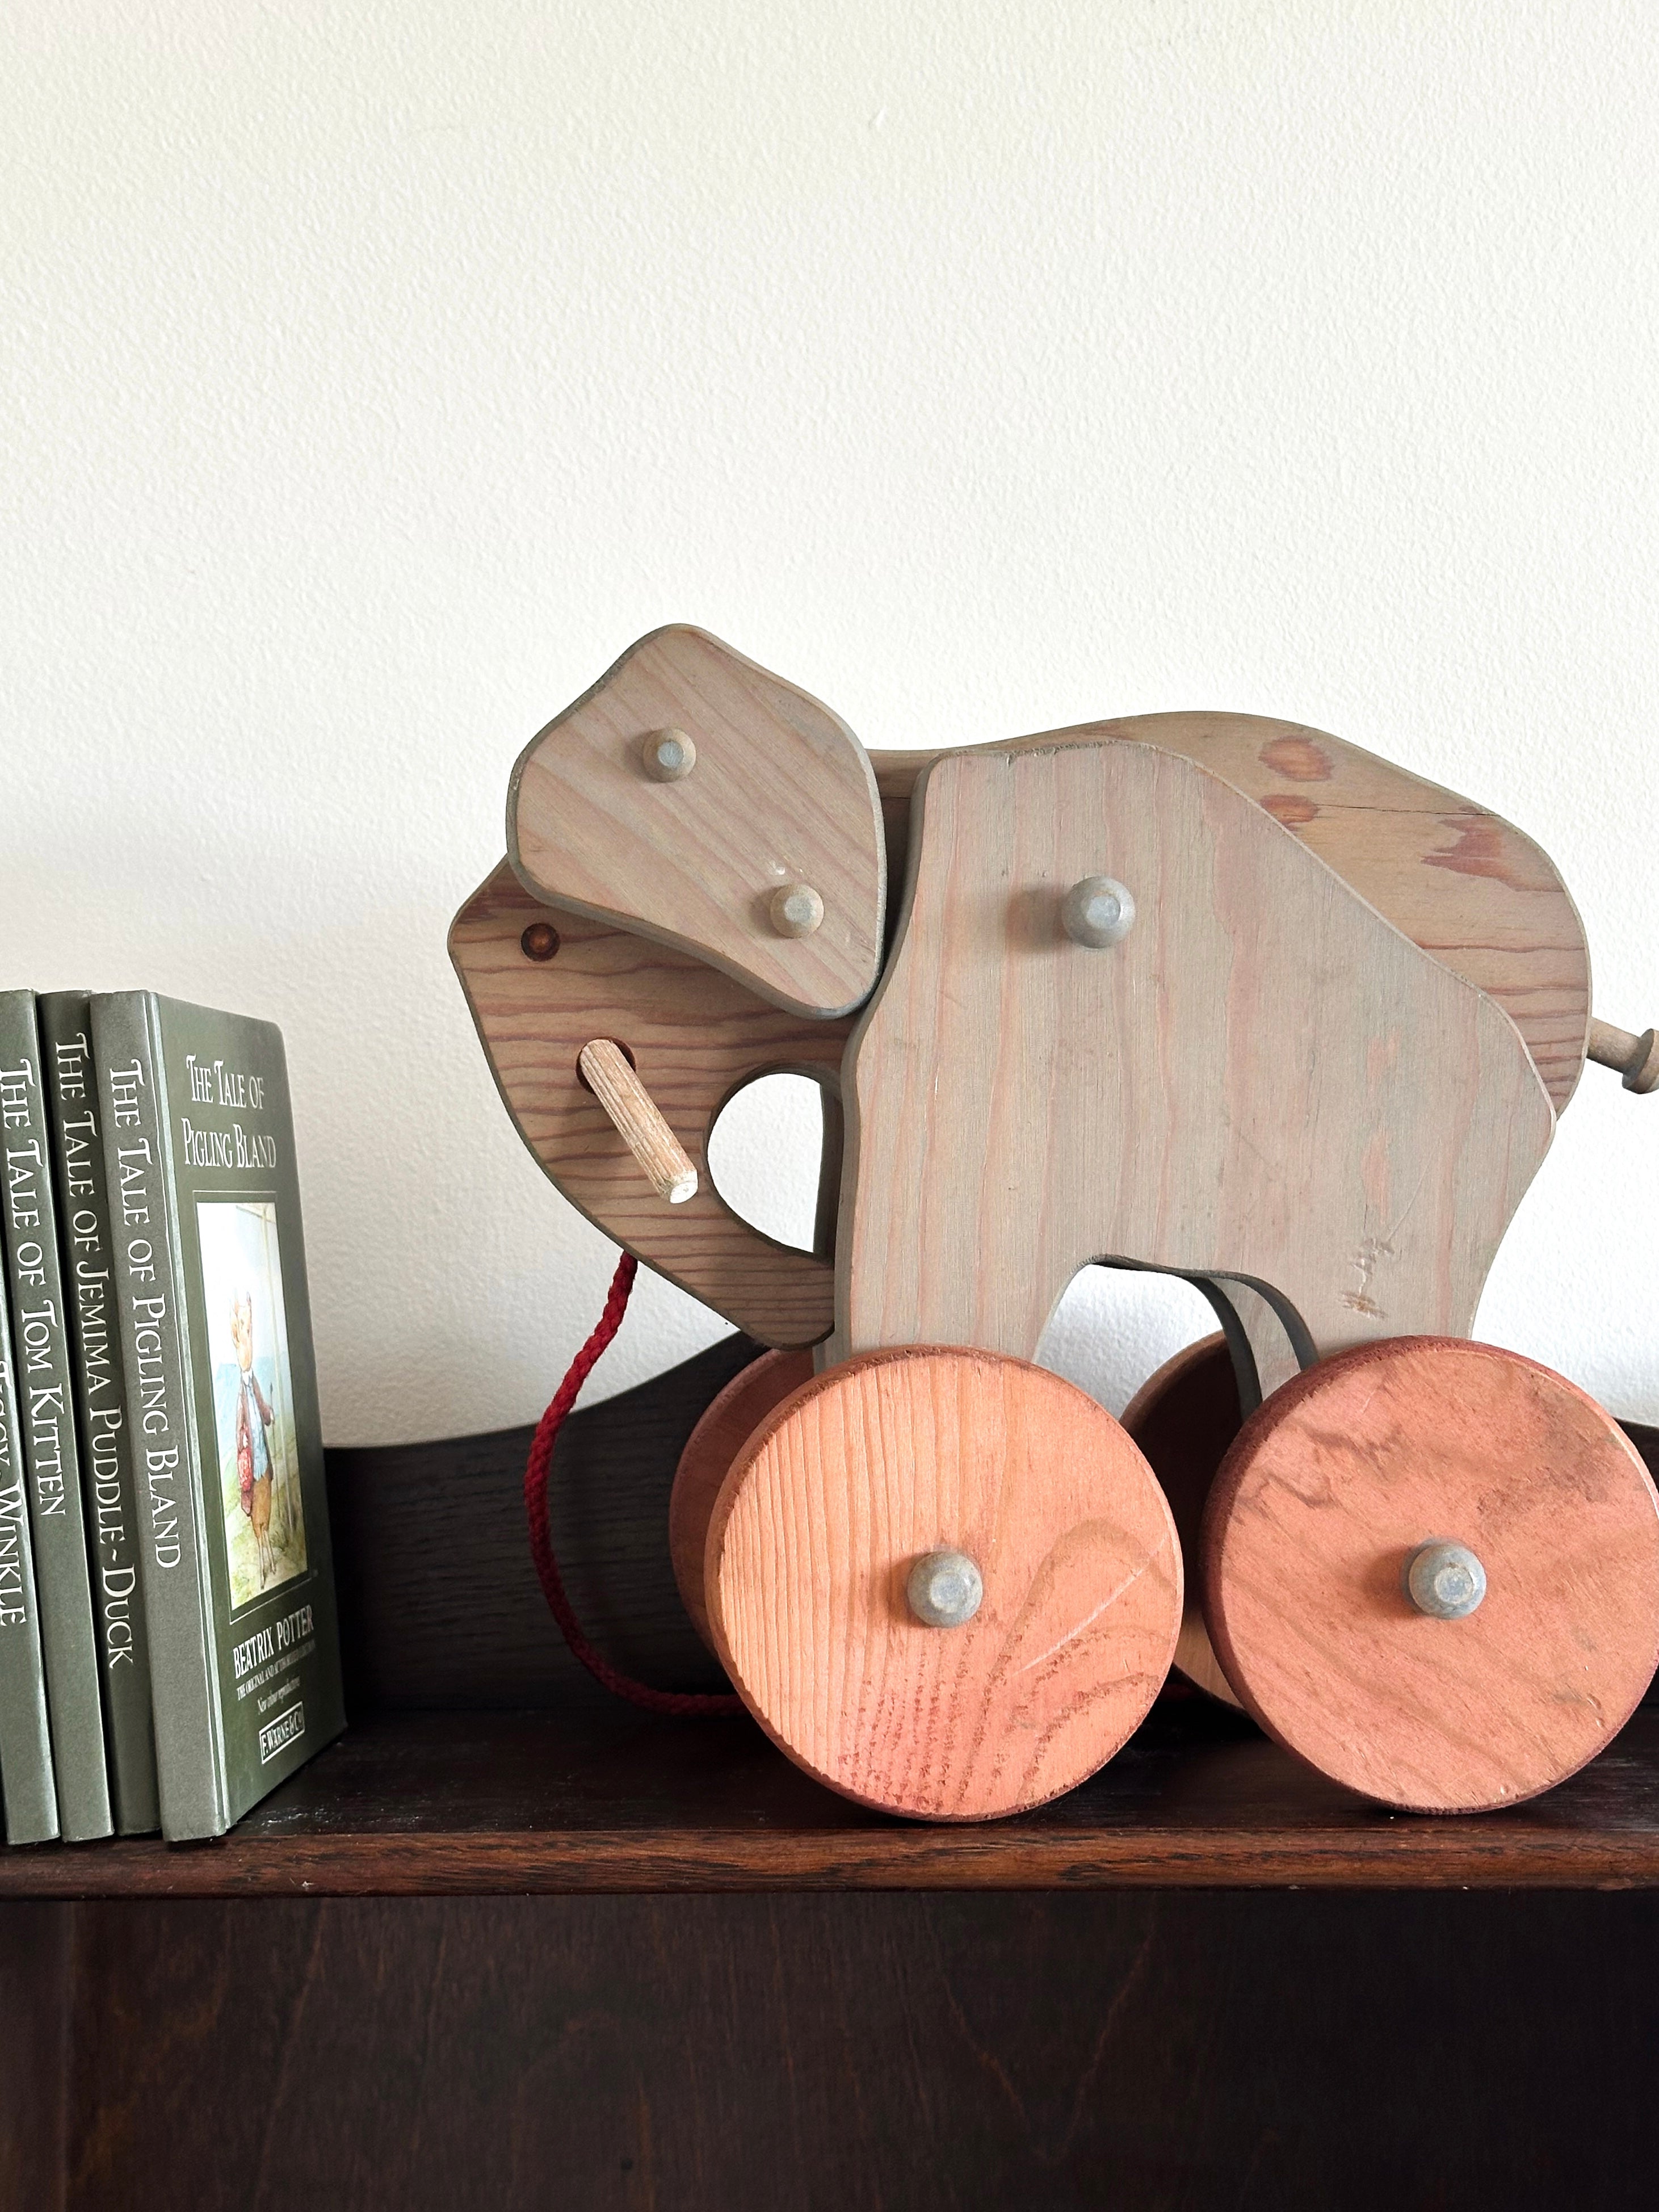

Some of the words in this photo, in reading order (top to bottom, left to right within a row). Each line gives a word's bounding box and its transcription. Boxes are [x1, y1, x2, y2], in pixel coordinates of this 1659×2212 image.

[0, 1058, 36, 1129] THE
[56, 1032, 91, 1101] THE
[109, 1058, 145, 1128] THE
[186, 1053, 213, 1103] THE
[213, 1059, 247, 1108] TALE
[249, 1075, 264, 1110] OF
[63, 1110, 98, 1197] TALE
[181, 1117, 233, 1169] PIGLING
[233, 1123, 277, 1168] BLAND
[6, 1139, 44, 1229] TALE
[117, 1138, 153, 1226] TALE
[17, 1241, 47, 1286] OF
[73, 1210, 103, 1252] OF
[128, 1239, 156, 1282] OF
[22, 1299, 58, 1374] TOM
[76, 1261, 112, 1395] JEMIMA
[132, 1293, 169, 1436] PIGLING
[29, 1383, 66, 1516] KITTEN
[146, 1445, 182, 1569] BLAND
[233, 1626, 274, 1680] BEATRIX
[276, 1604, 314, 1651] POTTER
